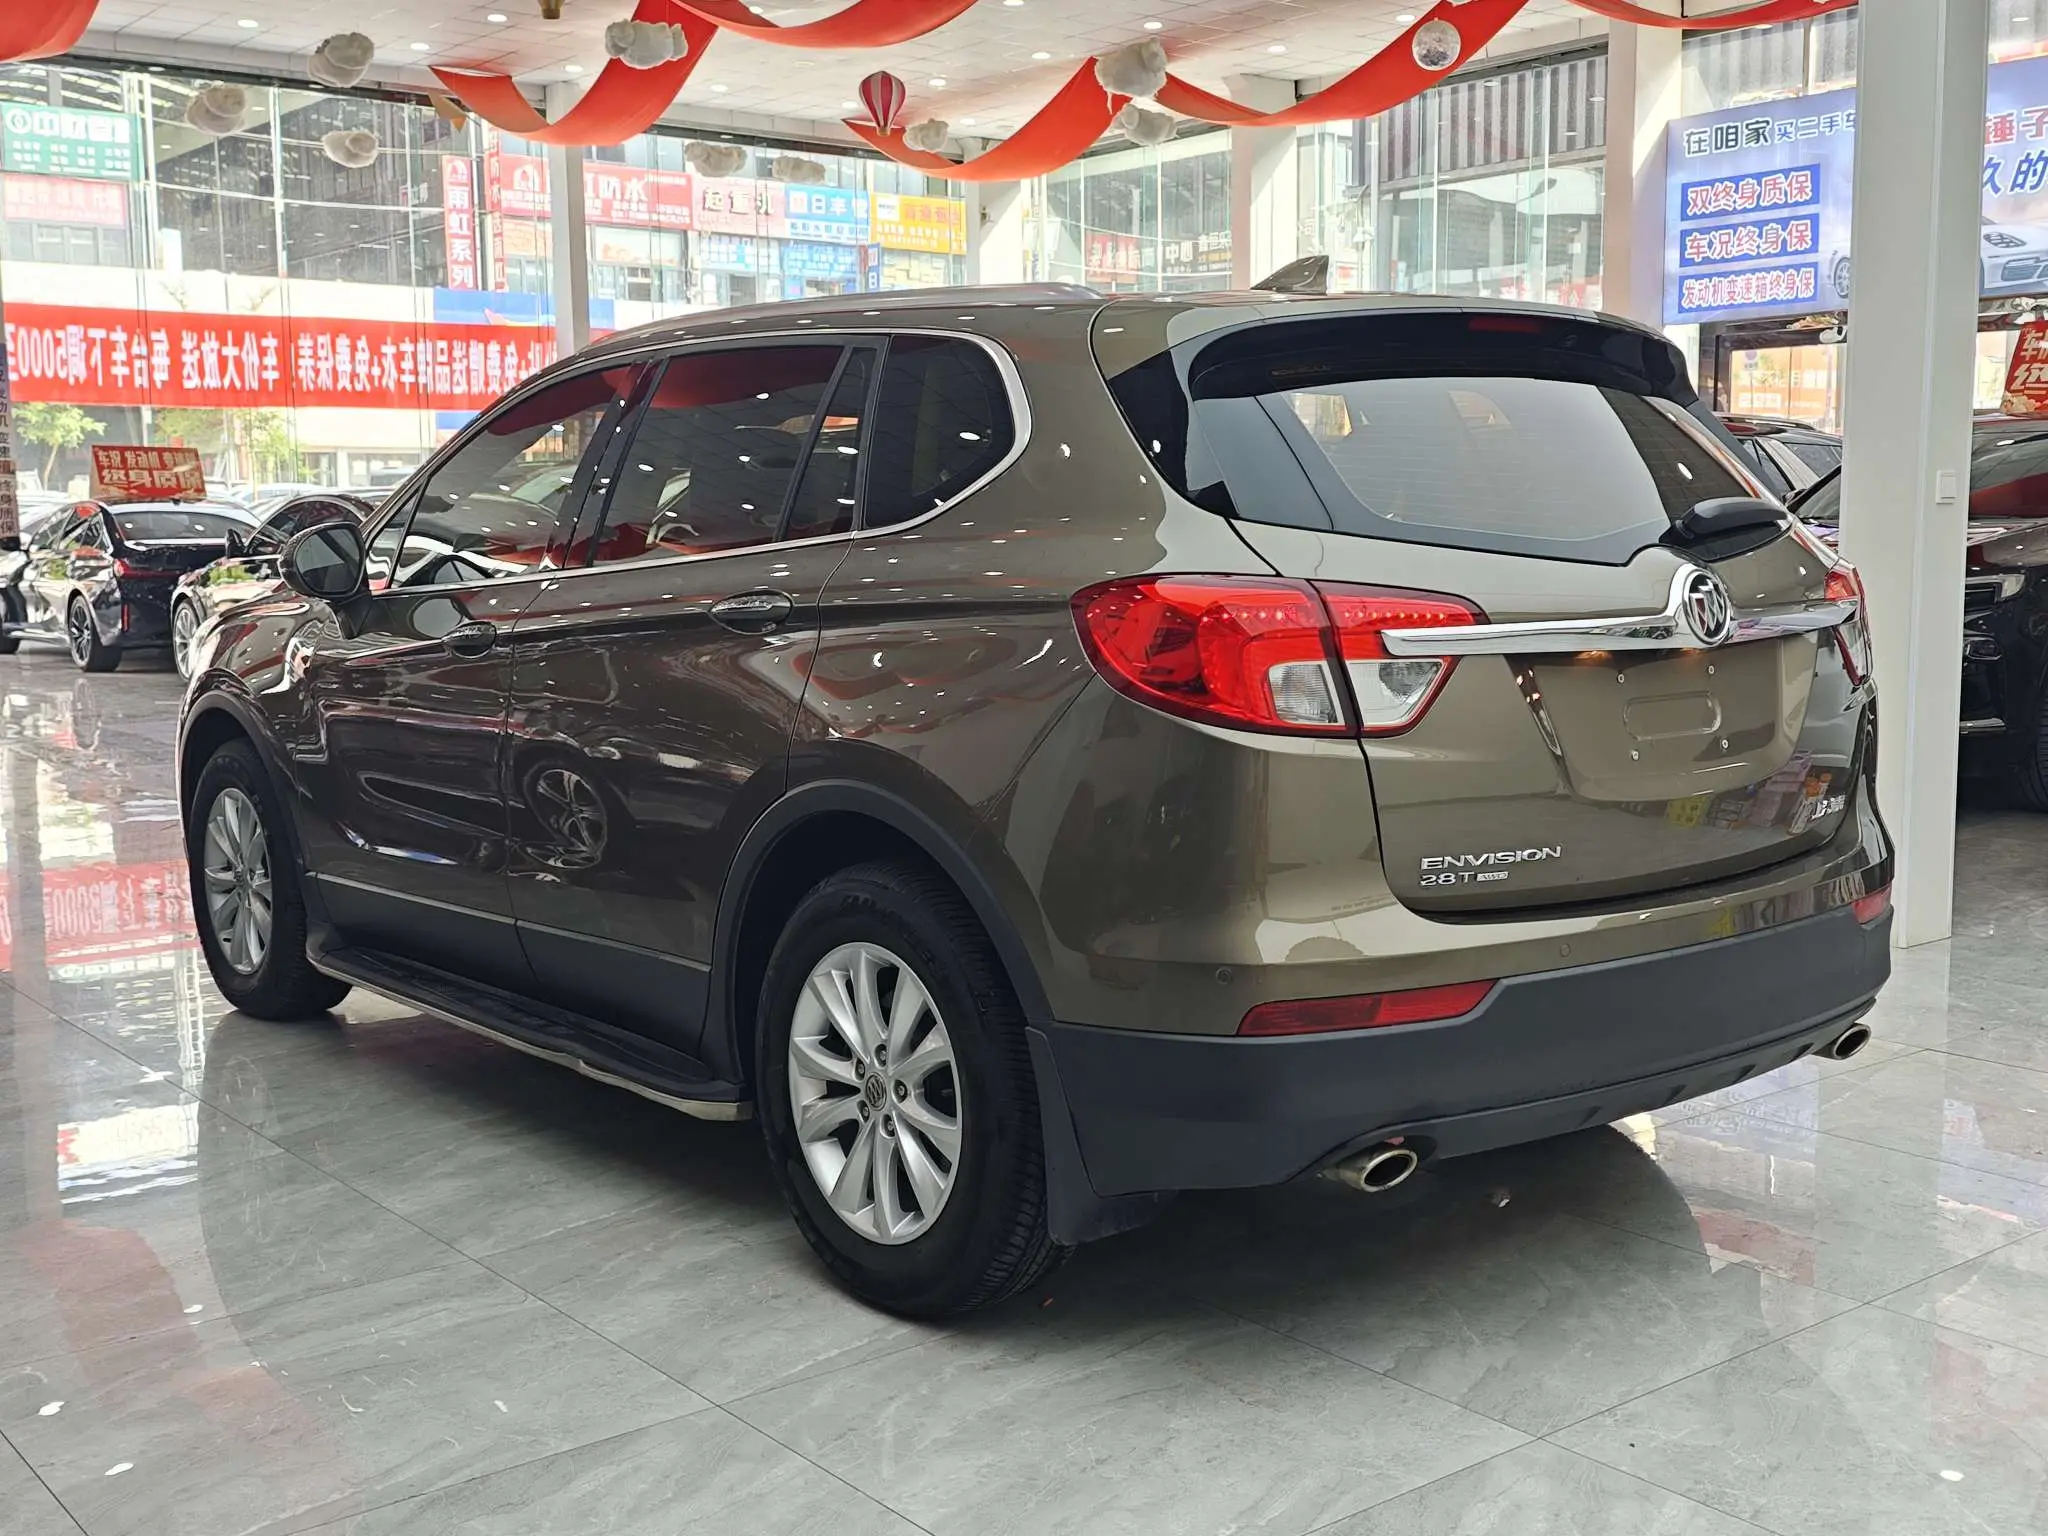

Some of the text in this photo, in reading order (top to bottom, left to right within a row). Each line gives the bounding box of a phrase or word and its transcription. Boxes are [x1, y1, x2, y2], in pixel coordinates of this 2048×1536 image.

[1688, 172, 1811, 215] 双终身质保
[449, 187, 473, 289] 雨虹系列
[1686, 221, 1811, 261] 车况终身保
[1681, 268, 1815, 308] 发动机变速箱终身保
[1420, 846, 1562, 870] ENVISION
[1420, 872, 1475, 886] 28T
